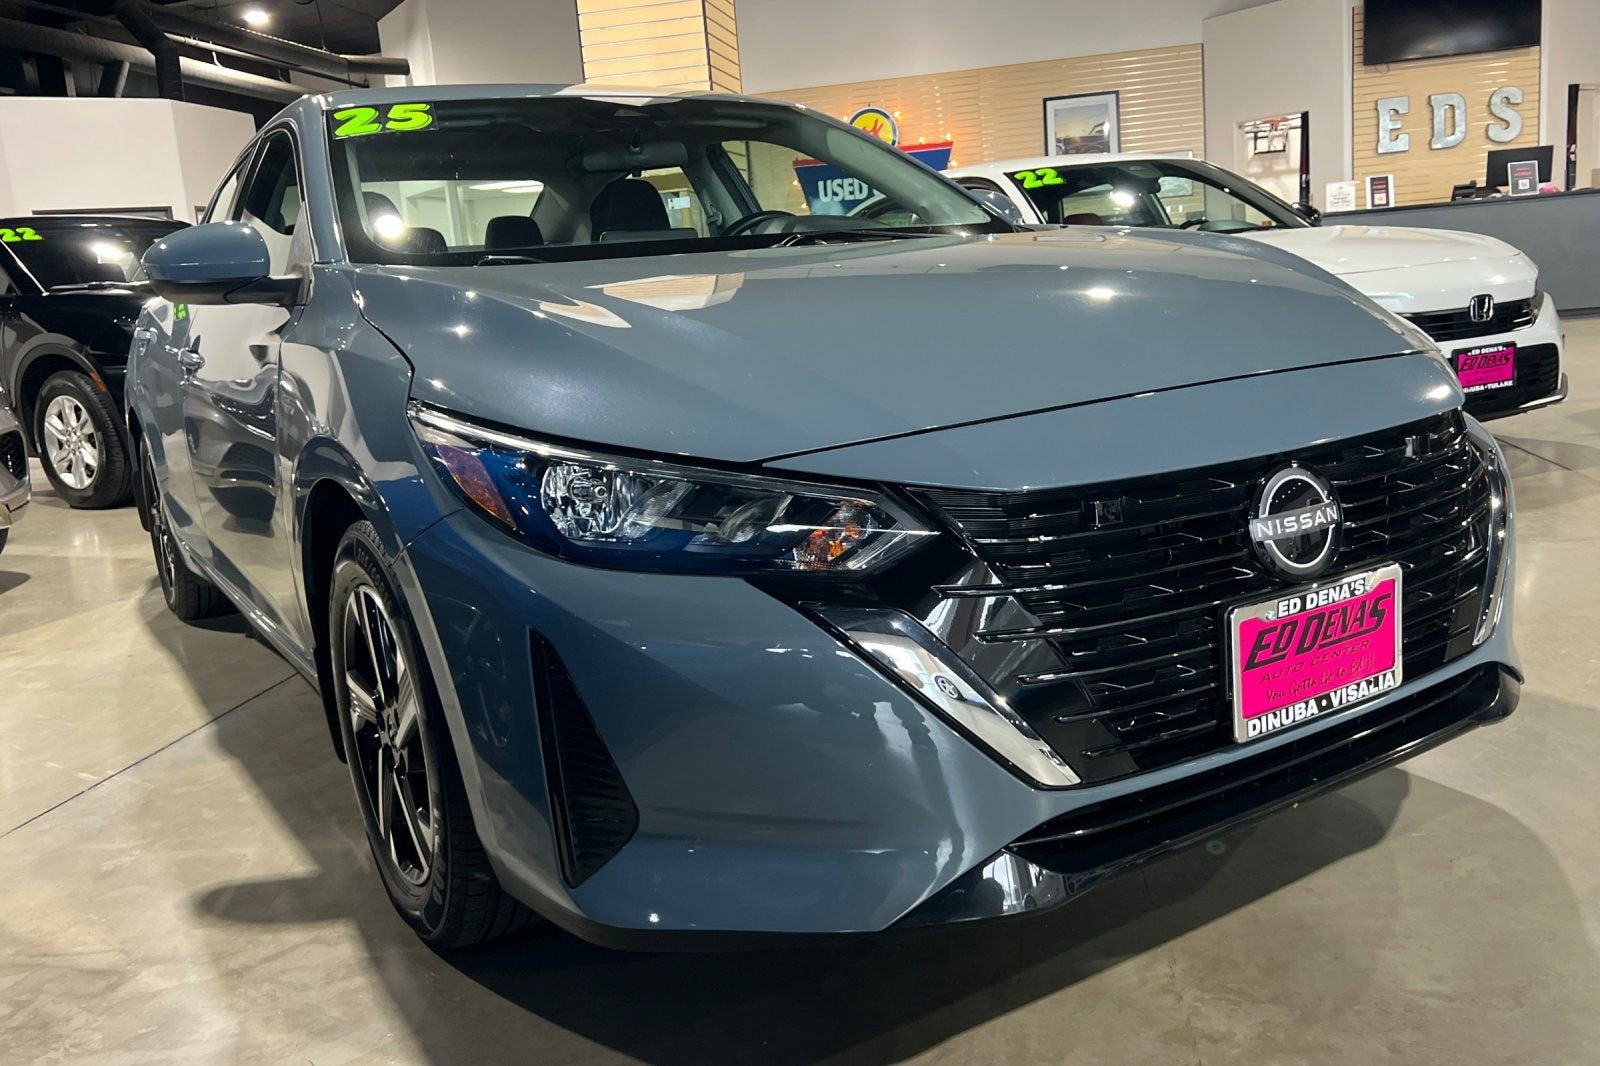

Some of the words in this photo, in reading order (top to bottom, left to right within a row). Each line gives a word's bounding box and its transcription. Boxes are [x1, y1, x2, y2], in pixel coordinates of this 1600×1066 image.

[333, 104, 432, 137] 25
[817, 177, 869, 203] USED
[1013, 167, 1064, 189] 22
[0, 227, 43, 242] 22
[1256, 505, 1338, 538] NISSAN
[1278, 599, 1301, 618] ED
[1305, 581, 1365, 609] DENA'S
[1243, 619, 1299, 672] ED
[1261, 662, 1305, 683] AUTO
[1310, 640, 1370, 667] CENTER
[1266, 689, 1286, 704] You
[1336, 664, 1346, 680] to
[1247, 699, 1320, 738] DINUBA
[1329, 671, 1395, 708] VISALIA
